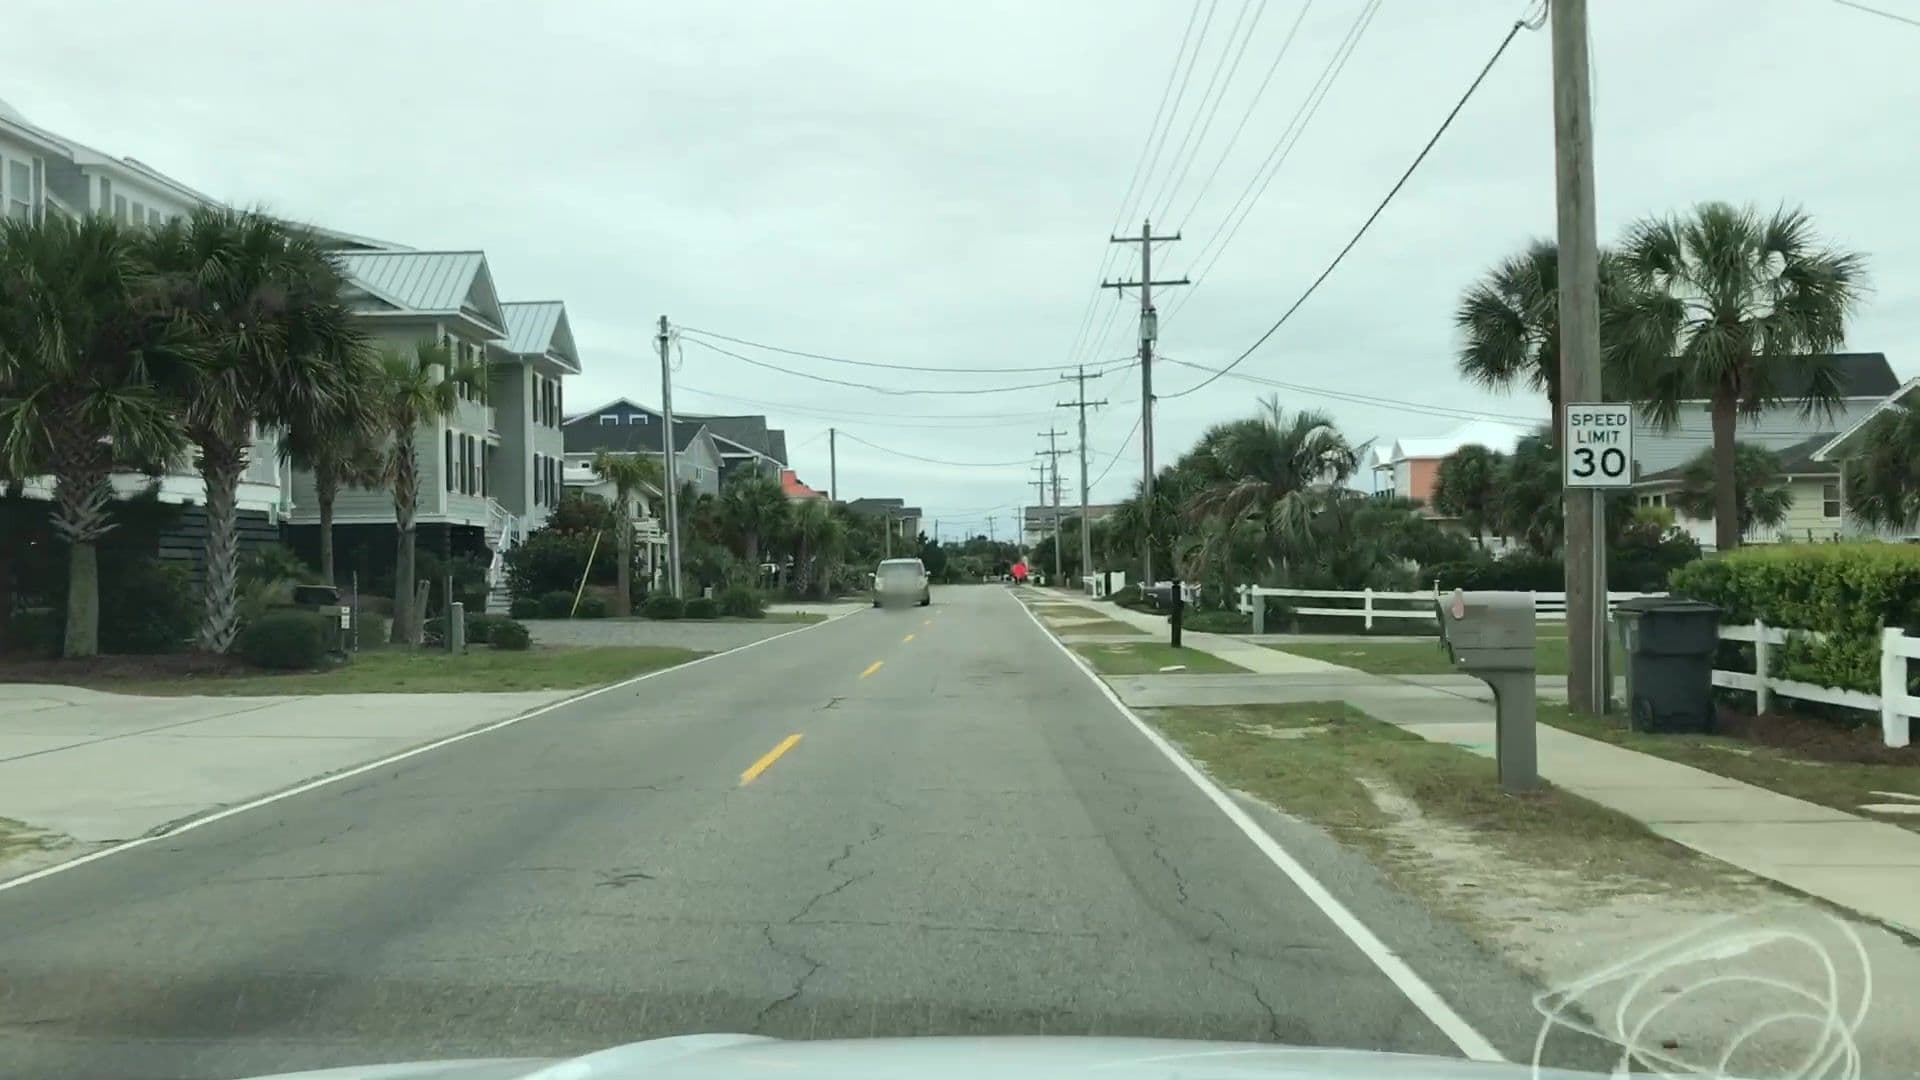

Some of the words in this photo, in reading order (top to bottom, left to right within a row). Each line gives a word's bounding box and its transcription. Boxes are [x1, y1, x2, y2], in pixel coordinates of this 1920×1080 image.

[1571, 414, 1627, 426] SPEED
[1577, 430, 1620, 443] LIMIT
[1573, 448, 1625, 477] 30
